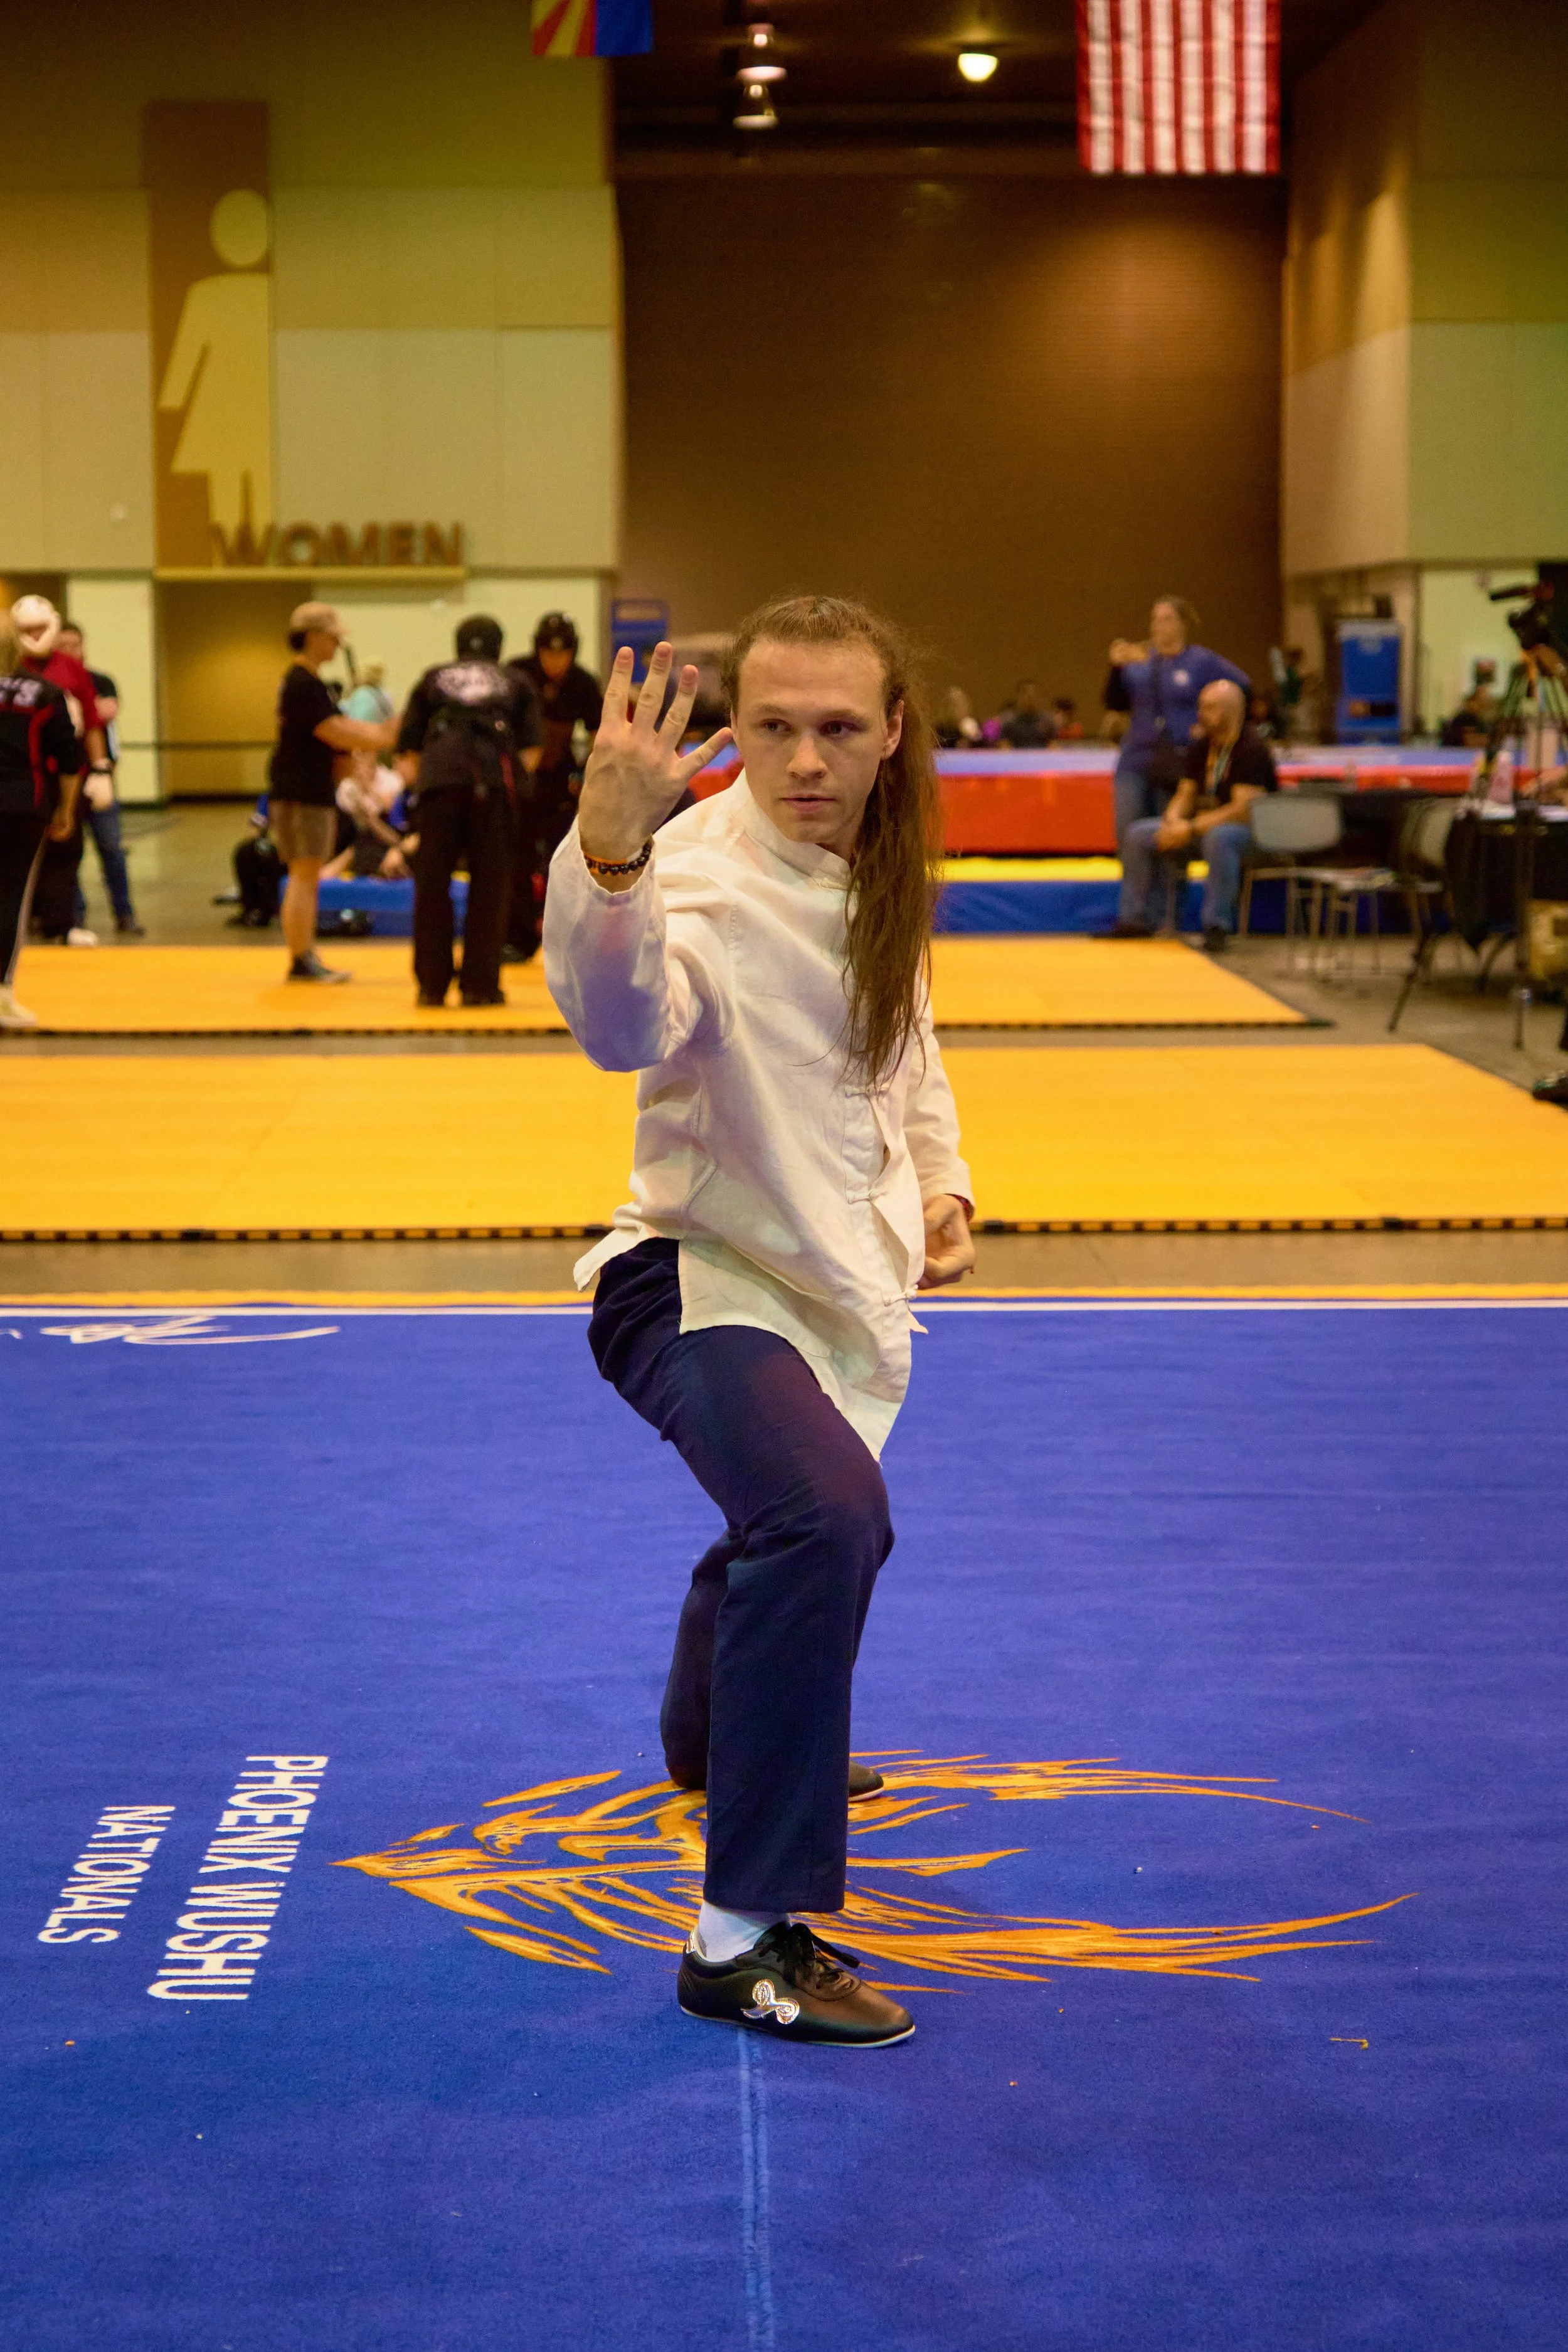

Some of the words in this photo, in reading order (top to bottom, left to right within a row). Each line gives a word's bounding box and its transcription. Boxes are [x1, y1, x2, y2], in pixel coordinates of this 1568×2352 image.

[208, 520, 464, 566] WOMEN
[198, 1756, 329, 1874] PHOENIX
[38, 1805, 176, 1944] NATIONALS
[147, 1882, 285, 2000] WUSHU
